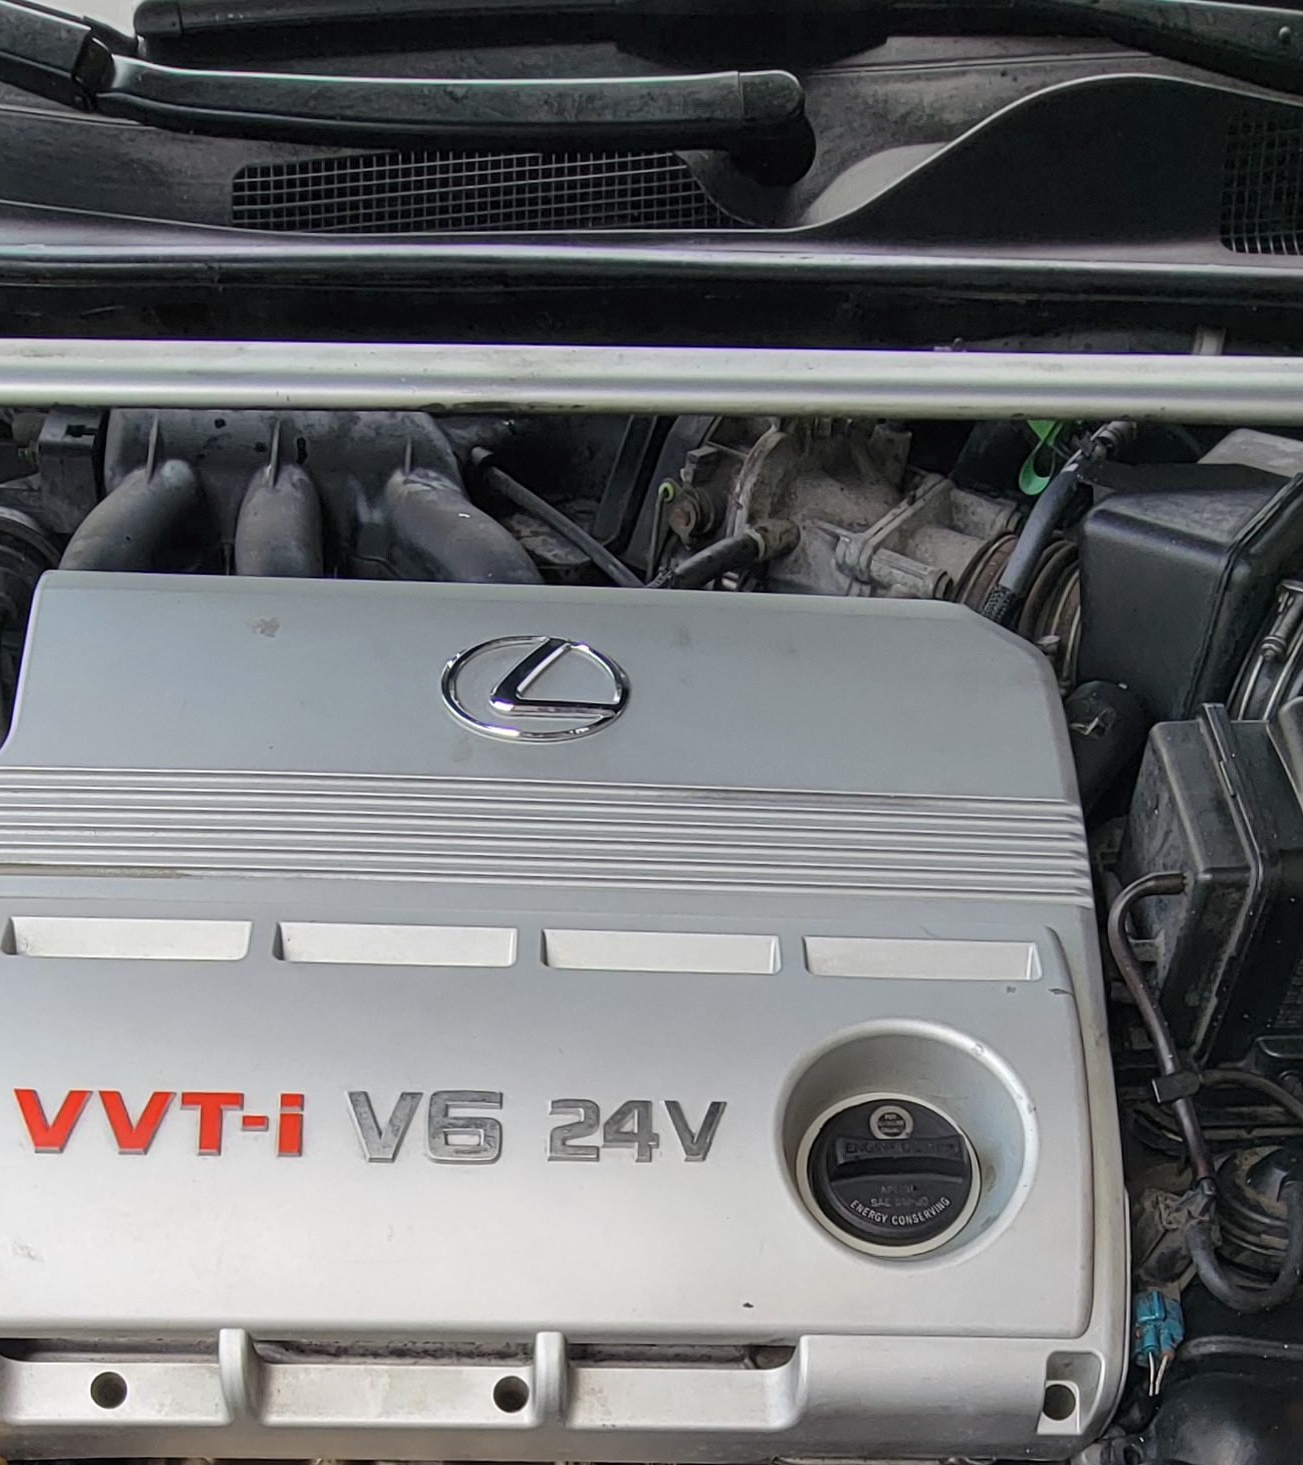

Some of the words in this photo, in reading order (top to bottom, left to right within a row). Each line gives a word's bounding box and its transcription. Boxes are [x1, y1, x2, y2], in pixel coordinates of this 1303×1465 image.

[13, 1087, 305, 1158] VVT-i
[347, 1089, 506, 1166] V6
[547, 1098, 729, 1164] 24V
[850, 1199, 888, 1224] ENERGY
[892, 1196, 951, 1225] CONSERVING
